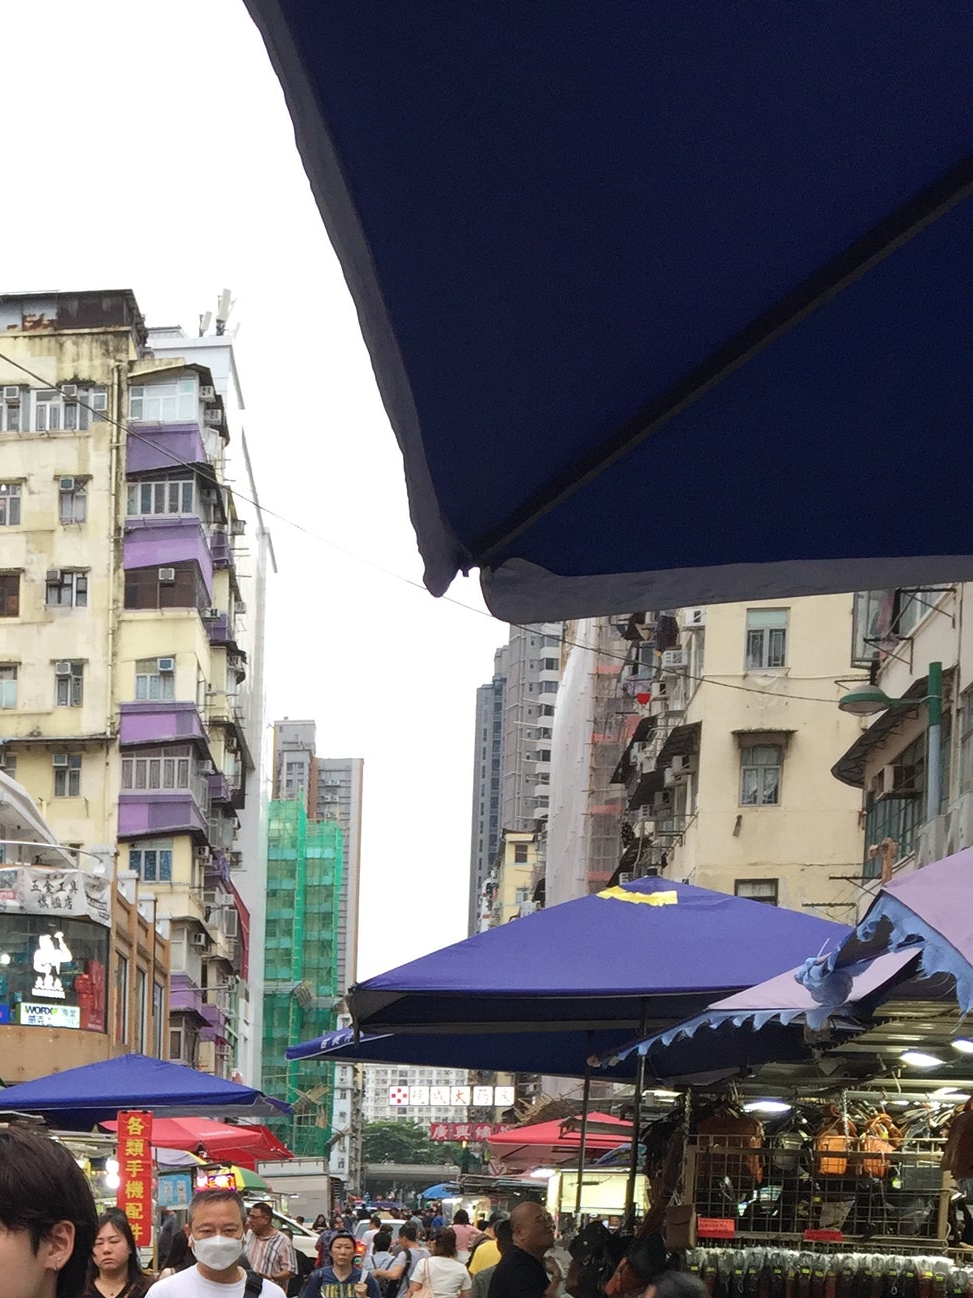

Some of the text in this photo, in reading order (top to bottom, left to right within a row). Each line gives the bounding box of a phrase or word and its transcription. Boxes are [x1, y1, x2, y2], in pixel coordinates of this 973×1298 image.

[30, 879, 79, 894] 五金工具
[125, 1116, 145, 1241] 各類手機配件
